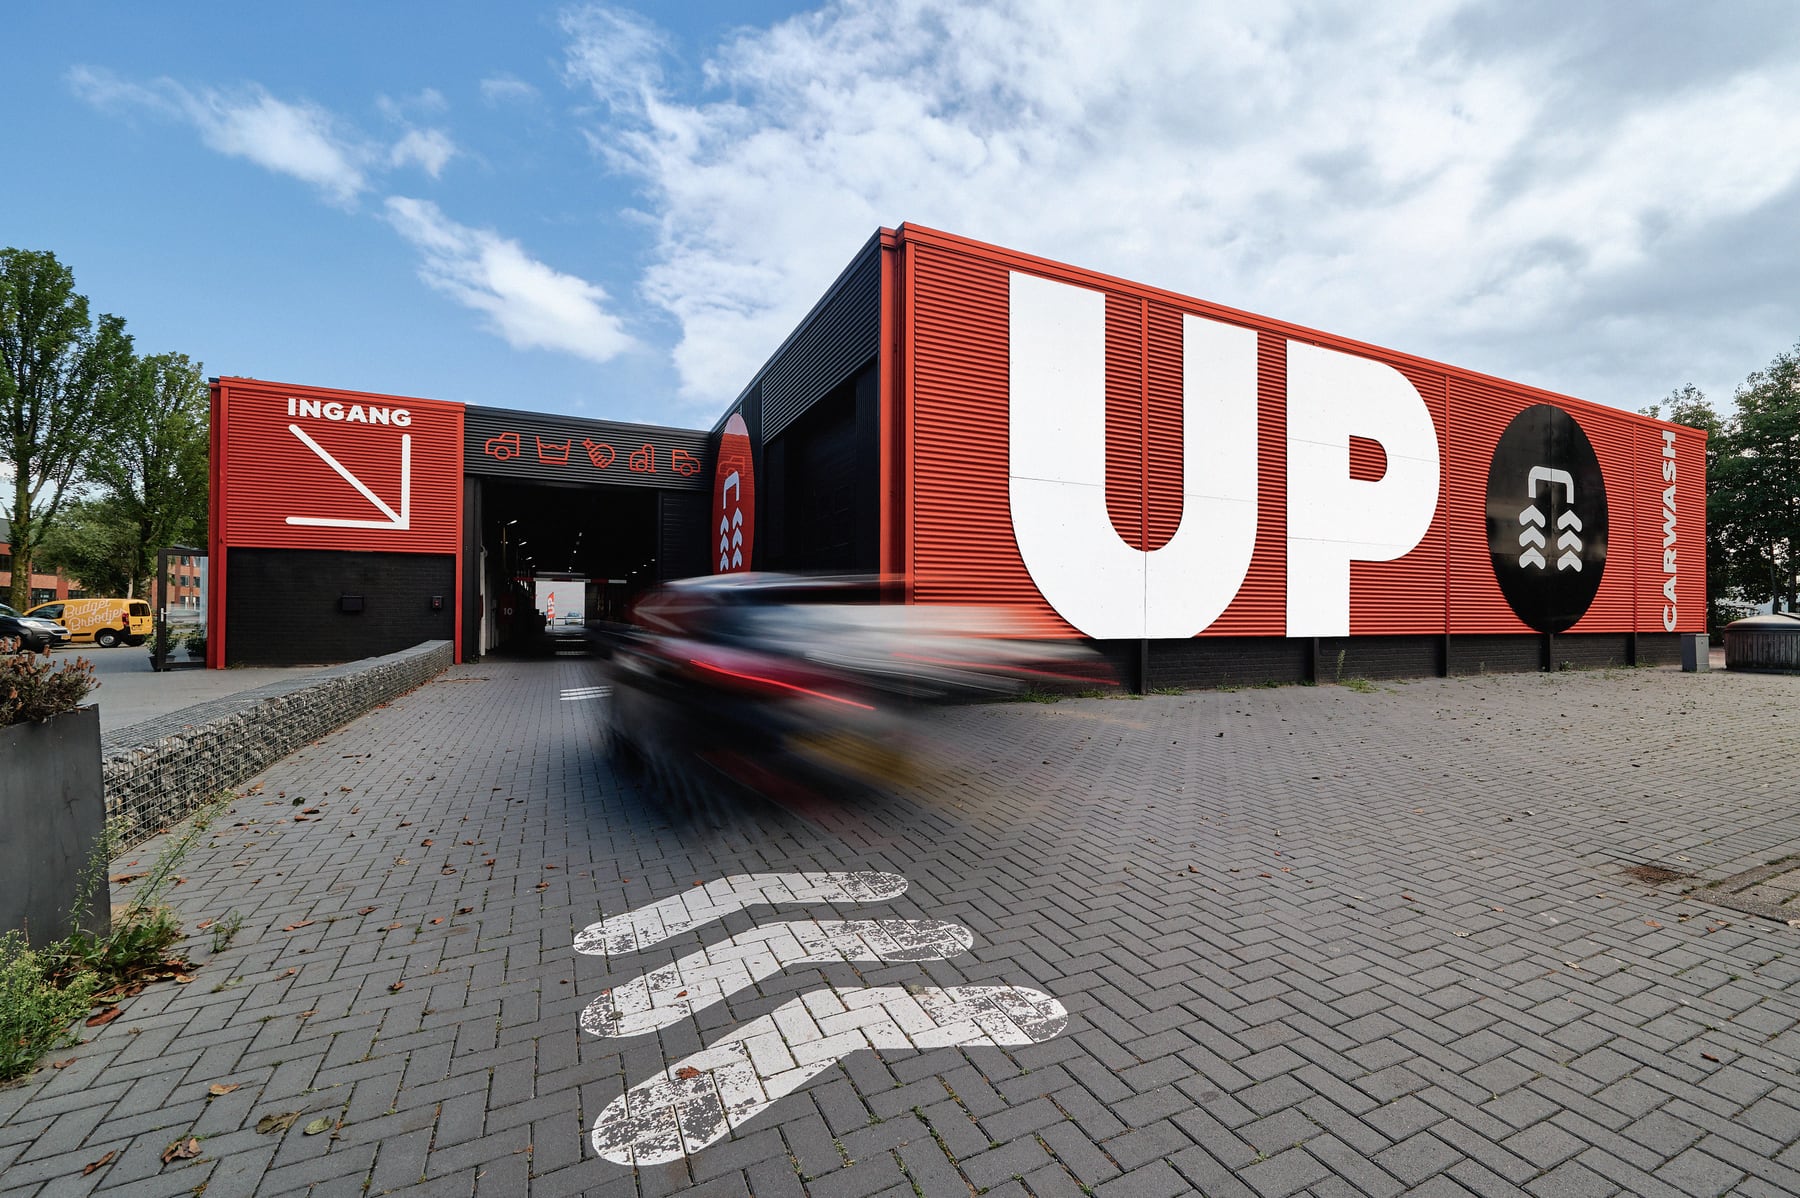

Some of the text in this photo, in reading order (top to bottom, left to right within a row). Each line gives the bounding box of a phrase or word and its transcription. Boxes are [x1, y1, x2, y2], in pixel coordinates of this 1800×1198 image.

[288, 398, 411, 427] INGANG
[1009, 270, 1440, 639] UP
[1662, 430, 1677, 632] CARWASH
[64, 600, 111, 619] Budget
[503, 607, 513, 616] 10
